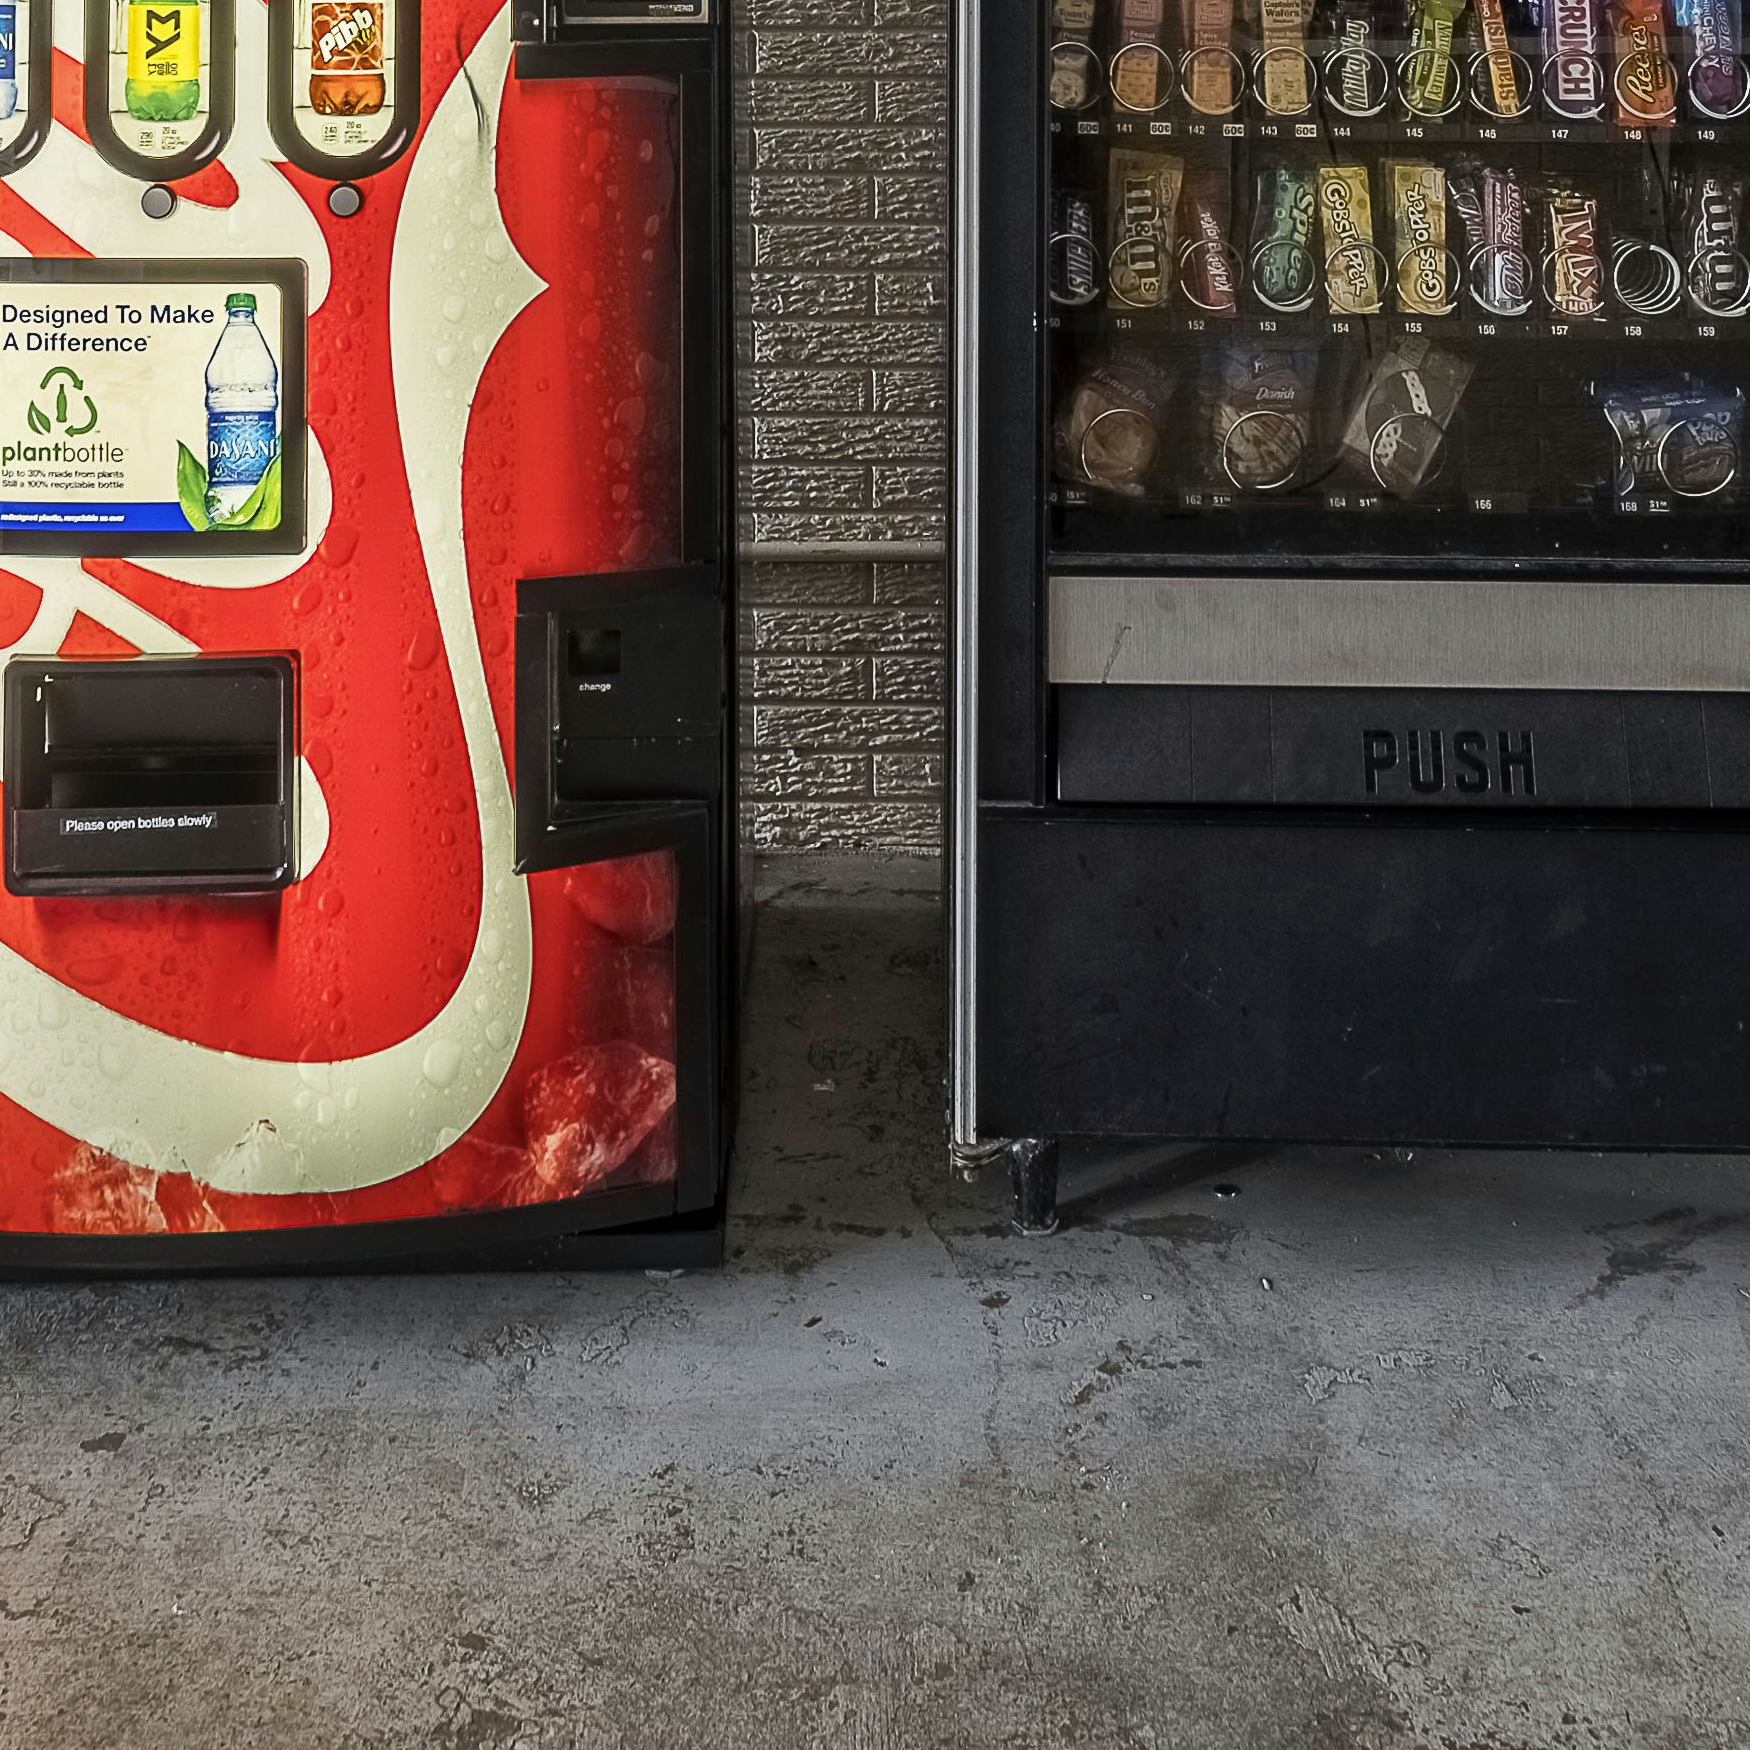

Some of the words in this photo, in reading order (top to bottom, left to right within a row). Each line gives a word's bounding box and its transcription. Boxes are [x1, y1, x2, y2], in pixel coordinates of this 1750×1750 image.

[1263, 0, 1301, 11] Captain's
[1265, 8, 1301, 19] Wafers
[317, 9, 375, 64] Pibb
[1116, 123, 1133, 133] 141
[1406, 128, 1423, 138] 145
[1551, 129, 1569, 139] 147
[1, 303, 109, 328] Designed
[115, 304, 143, 324] To
[150, 303, 215, 325] Make
[1115, 319, 1132, 329] 151
[1187, 320, 1205, 330] 152
[1259, 321, 1277, 331] 153
[1332, 323, 1350, 333] 154
[1404, 322, 1422, 333] 155
[1551, 325, 1569, 335] 157
[1624, 326, 1642, 336] 158
[1698, 326, 1715, 337] 159
[2, 332, 19, 351] A
[26, 332, 149, 352] Difference
[1255, 385, 1296, 401] Danish
[1, 440, 124, 467] plantbottle
[209, 435, 276, 463] DASANI
[1, 469, 15, 478] Up
[16, 469, 26, 477] to
[27, 469, 46, 478] 30%
[47, 469, 73, 478] made
[74, 469, 96, 478] from
[97, 470, 125, 480] plants
[50, 481, 96, 490] recyclable
[97, 480, 125, 489] bottle
[579, 682, 611, 692] change
[1362, 728, 1538, 797] PUSH
[65, 820, 104, 832] Please
[106, 819, 136, 832] open
[137, 816, 176, 830] bottles
[177, 814, 213, 828] slowly
